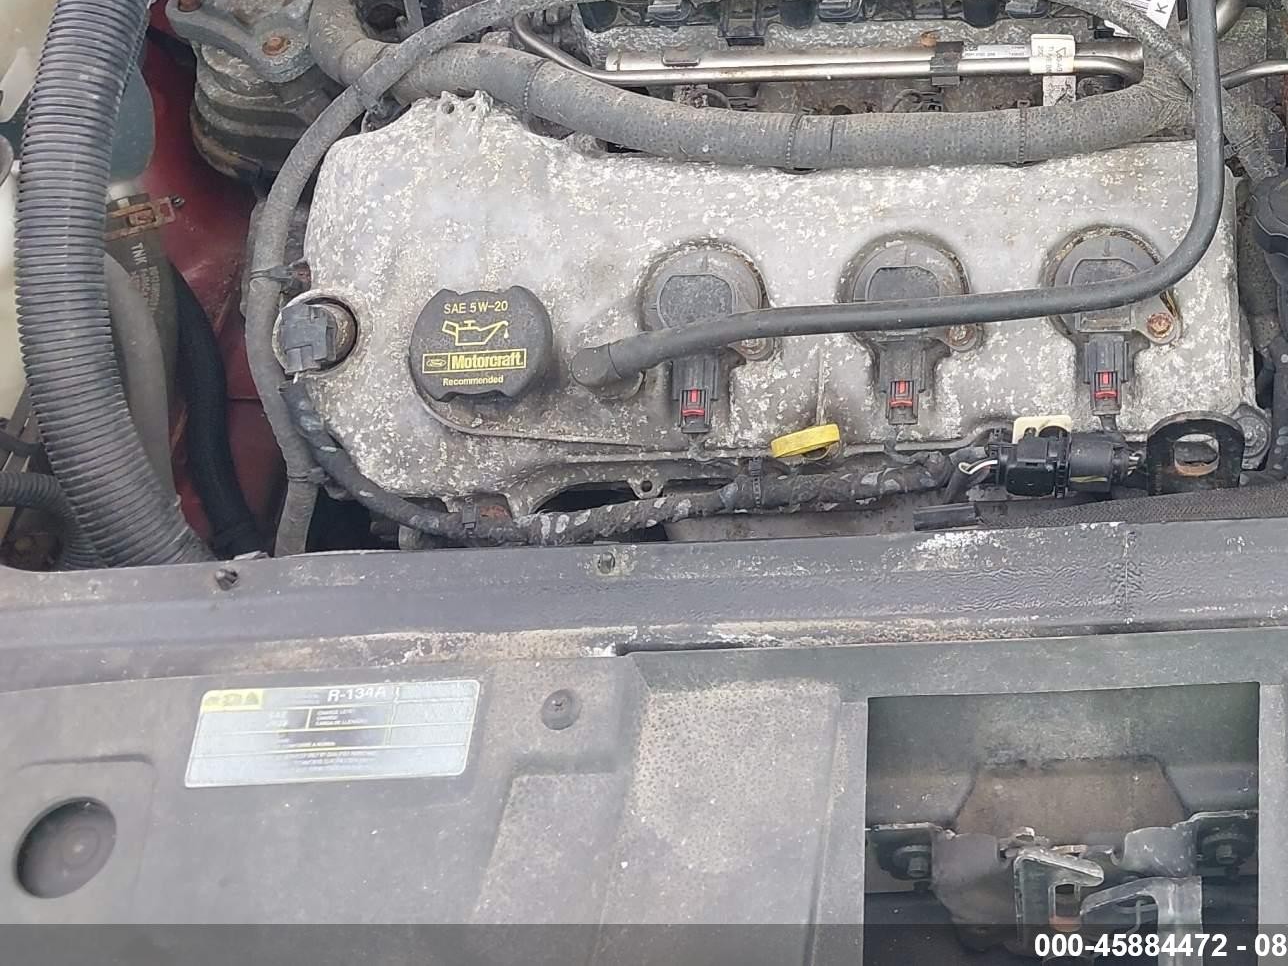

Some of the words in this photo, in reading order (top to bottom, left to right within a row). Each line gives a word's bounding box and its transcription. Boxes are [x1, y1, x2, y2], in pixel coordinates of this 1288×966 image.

[443, 303, 467, 314] SAE
[442, 375, 504, 386] Recommended
[327, 686, 387, 702] R-134A
